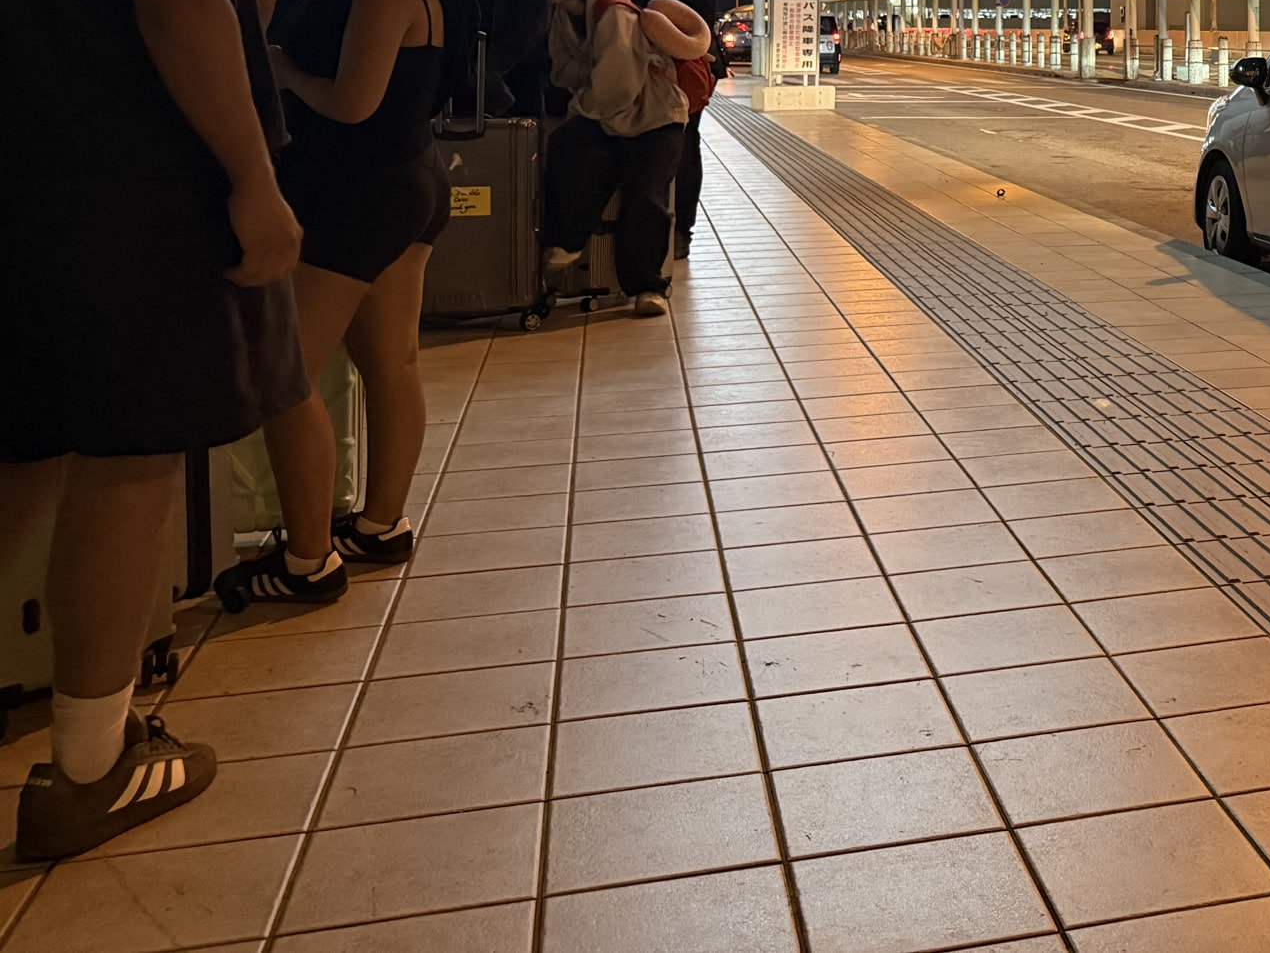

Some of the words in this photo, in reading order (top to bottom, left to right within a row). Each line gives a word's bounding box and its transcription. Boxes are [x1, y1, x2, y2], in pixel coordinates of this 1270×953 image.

[802, 1, 815, 68] バス降車専用
